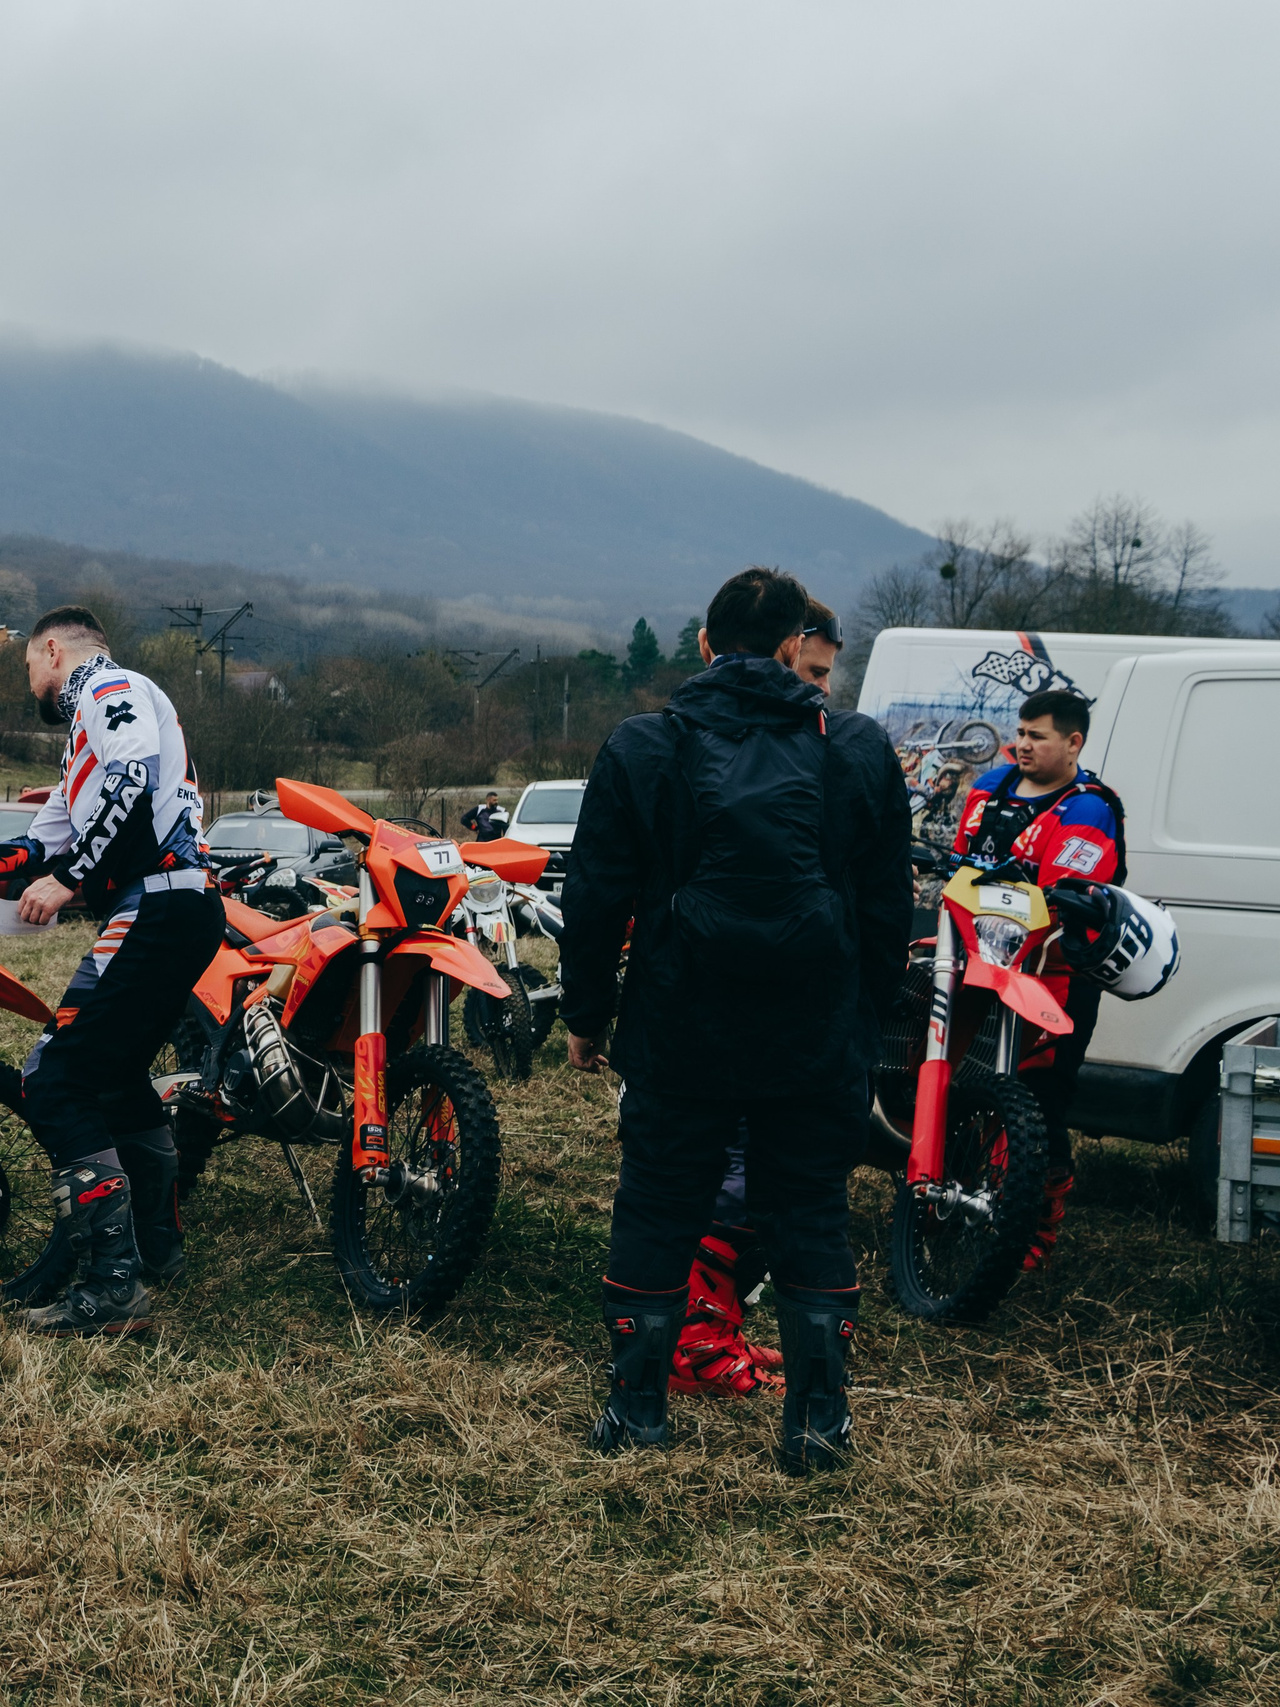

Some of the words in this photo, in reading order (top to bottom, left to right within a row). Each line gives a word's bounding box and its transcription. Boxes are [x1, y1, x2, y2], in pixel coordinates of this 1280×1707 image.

[433, 850, 450, 865] 77
[1052, 836, 1103, 875] 13
[1001, 892, 1013, 905] 5
